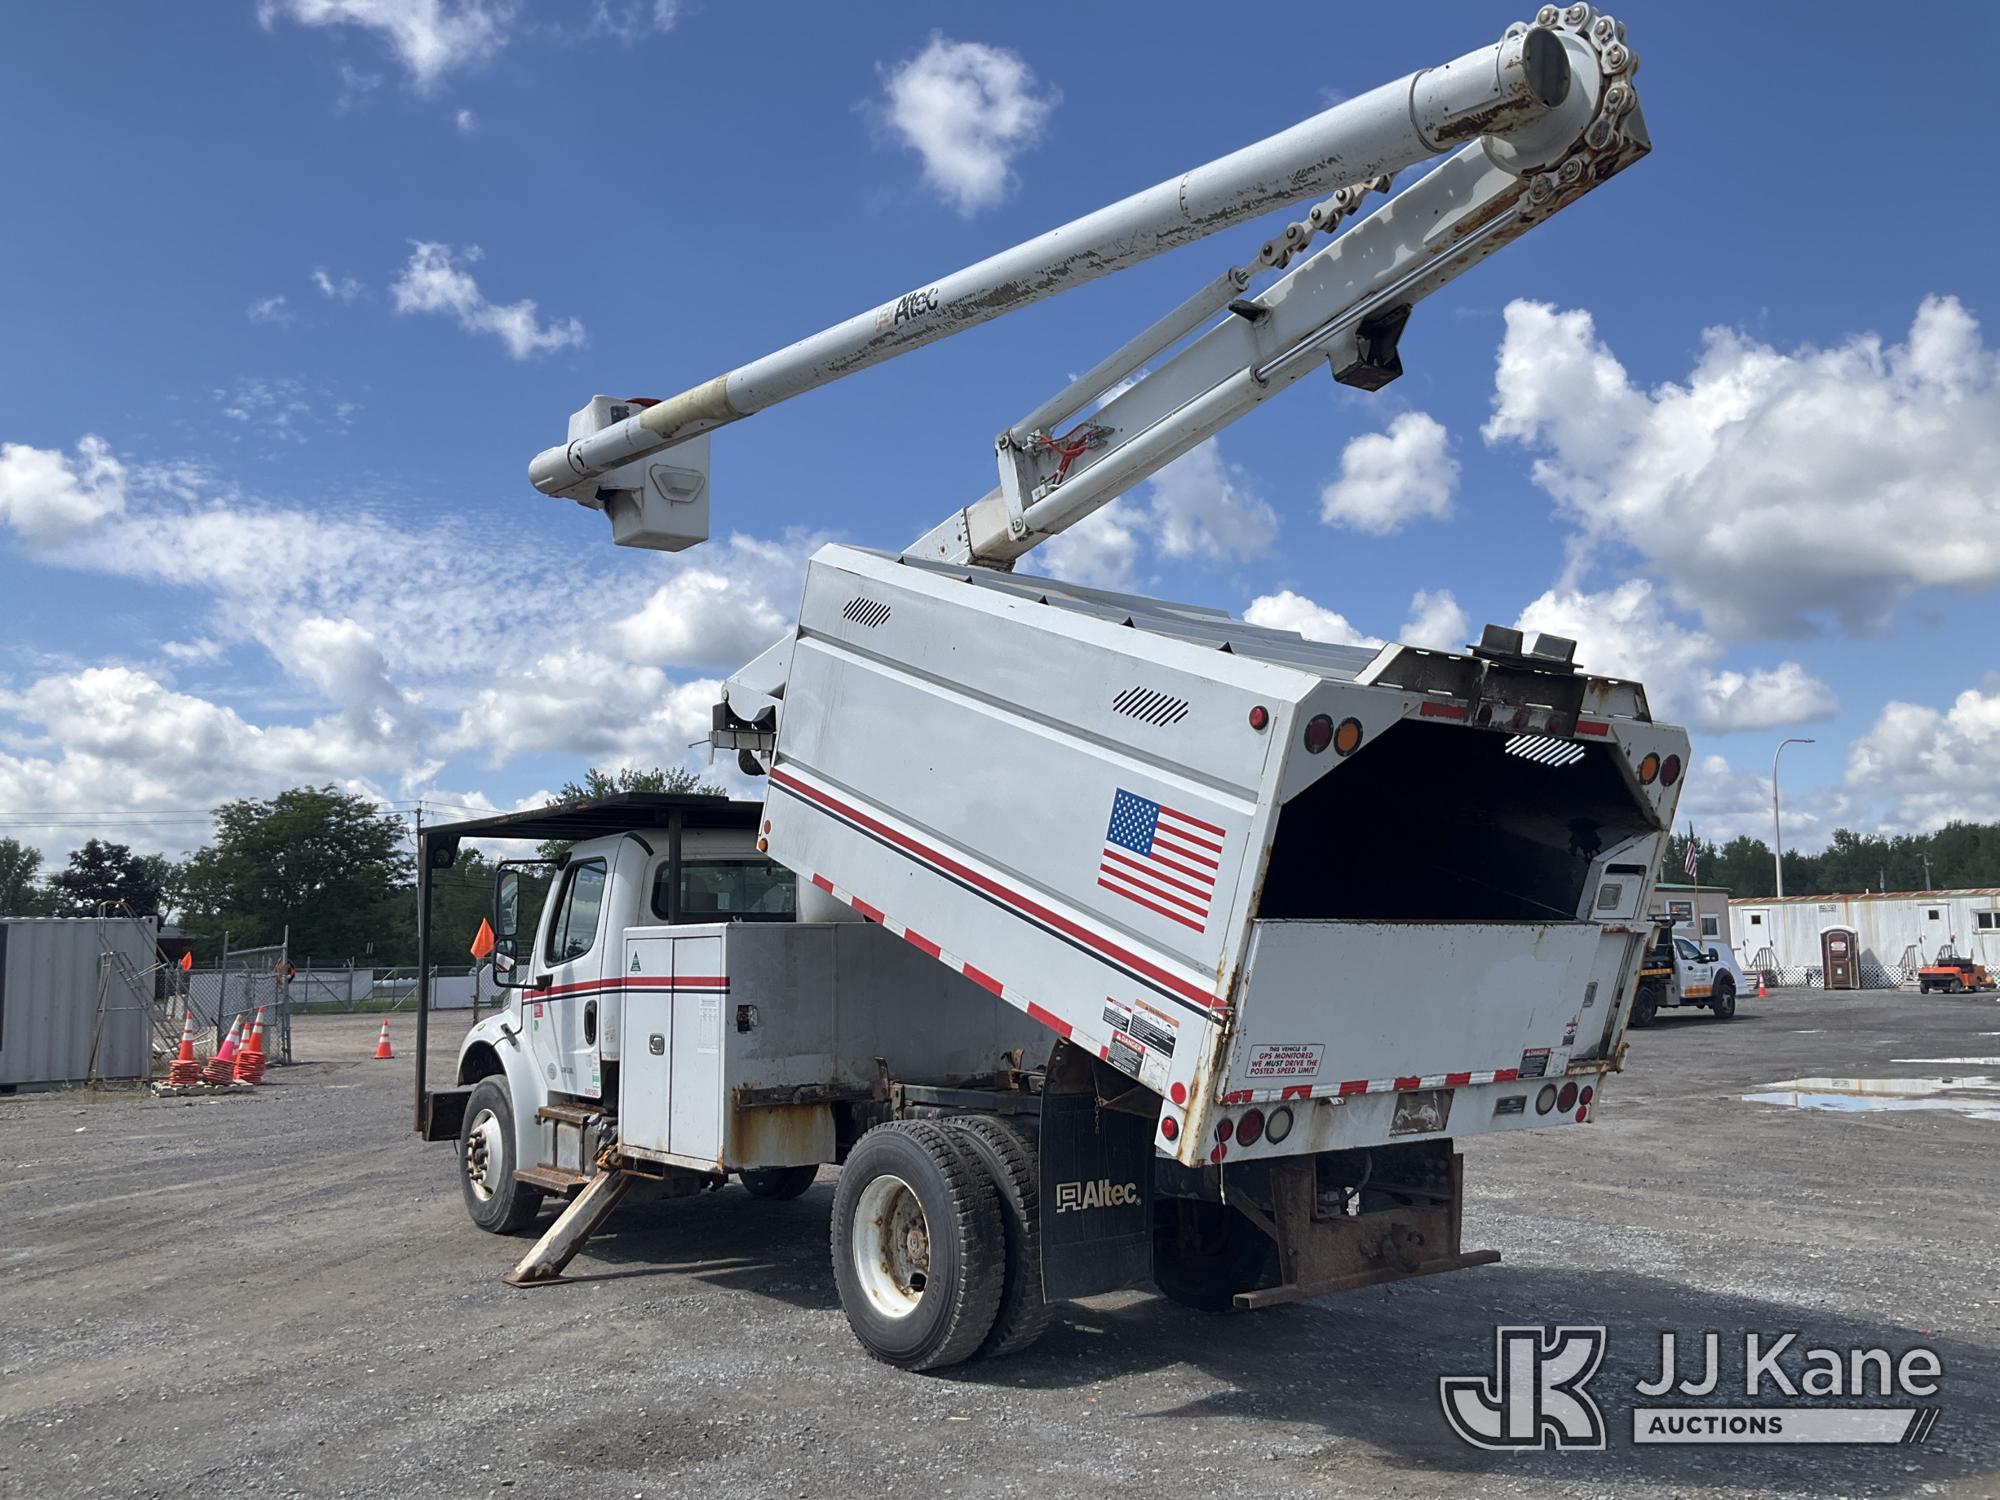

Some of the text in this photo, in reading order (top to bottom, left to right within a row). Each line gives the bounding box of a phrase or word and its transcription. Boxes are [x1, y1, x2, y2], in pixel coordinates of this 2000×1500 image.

[1259, 1052, 1272, 1060] GPS
[1250, 1067, 1275, 1075] POSTED
[1298, 1066, 1315, 1074] LIMIT
